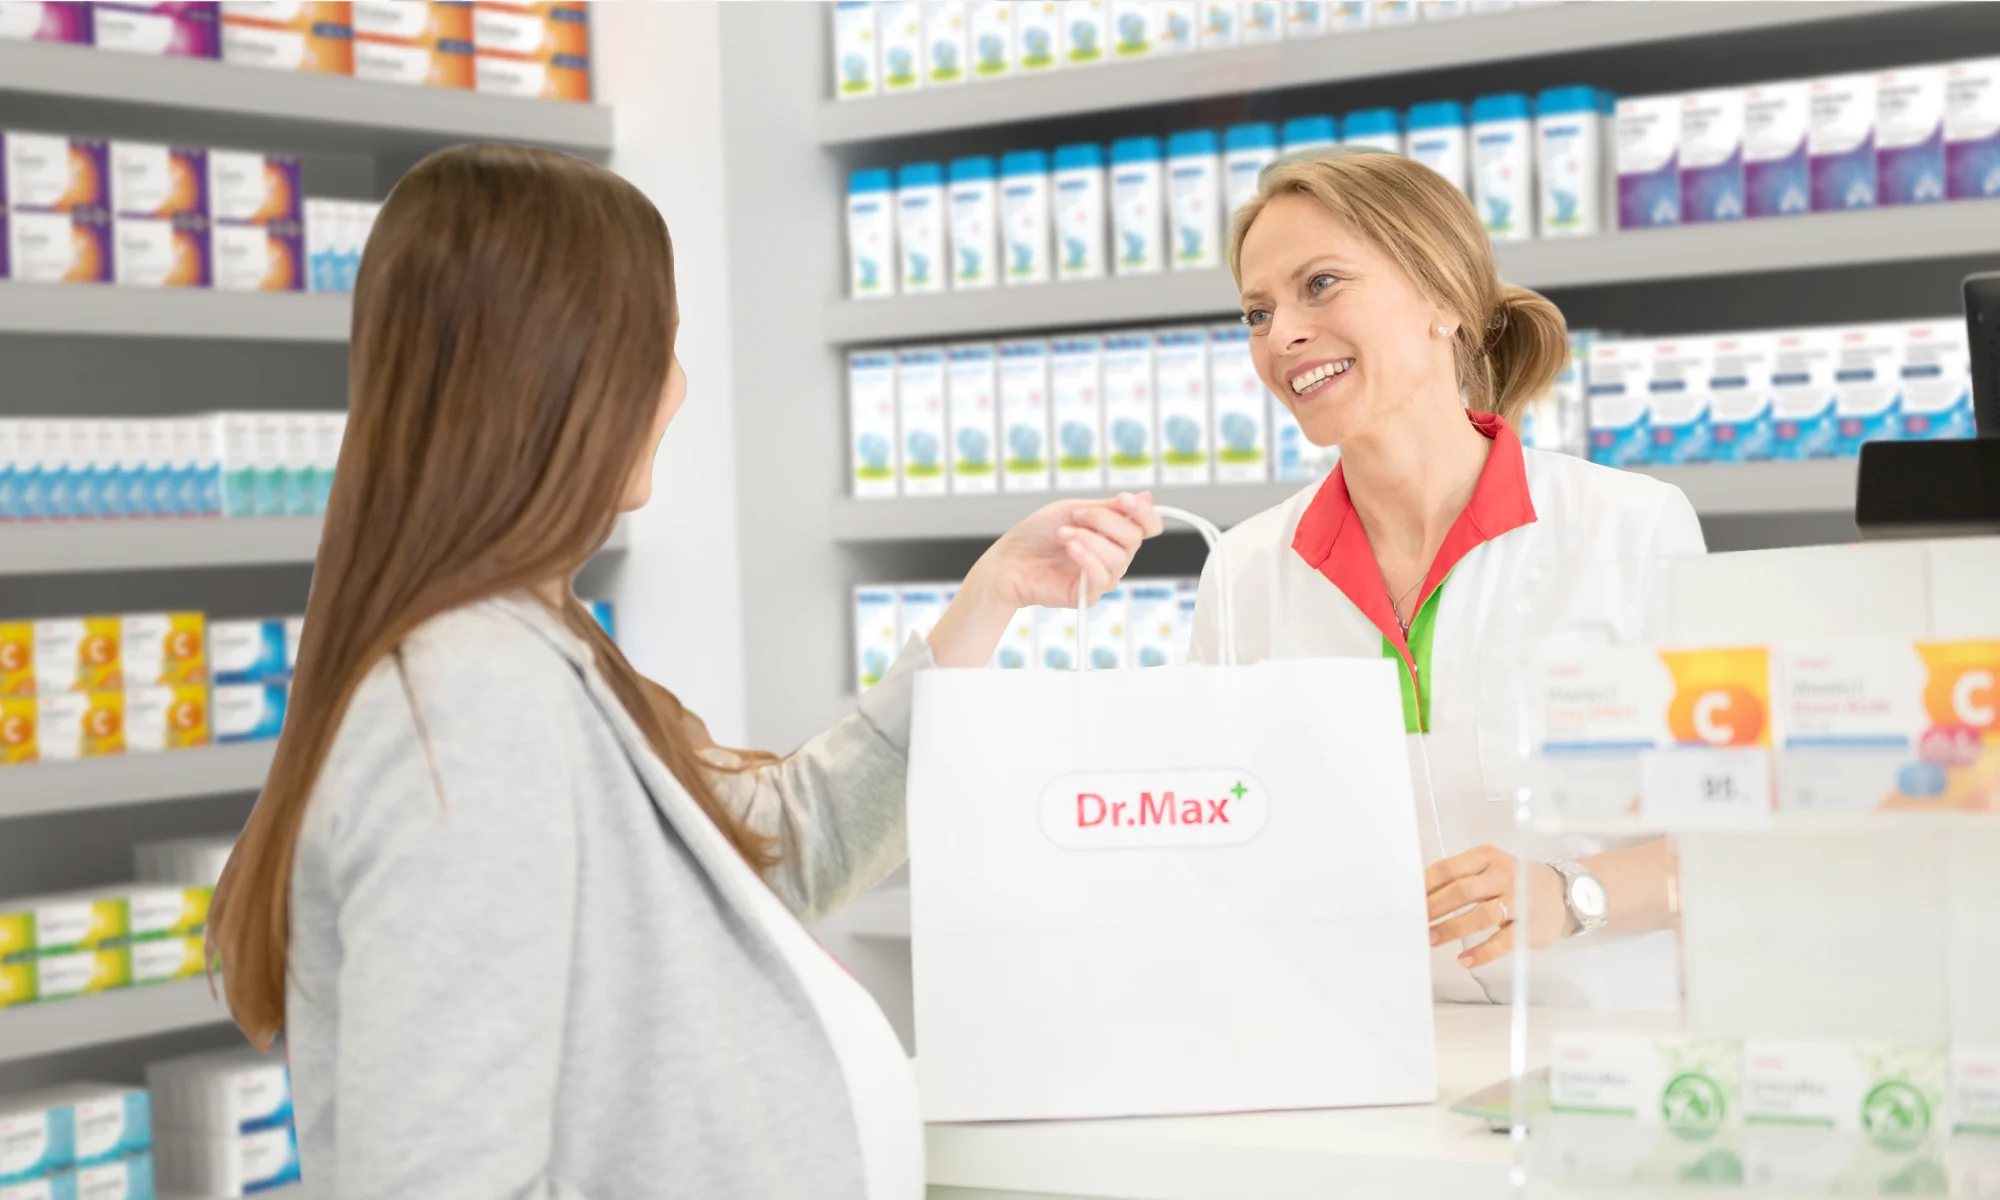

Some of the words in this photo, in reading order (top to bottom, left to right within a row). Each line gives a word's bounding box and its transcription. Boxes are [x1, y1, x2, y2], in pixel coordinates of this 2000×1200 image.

[1692, 691, 1735, 744] C
[1953, 669, 1995, 726] C
[1077, 791, 1230, 828] Dr.Max
